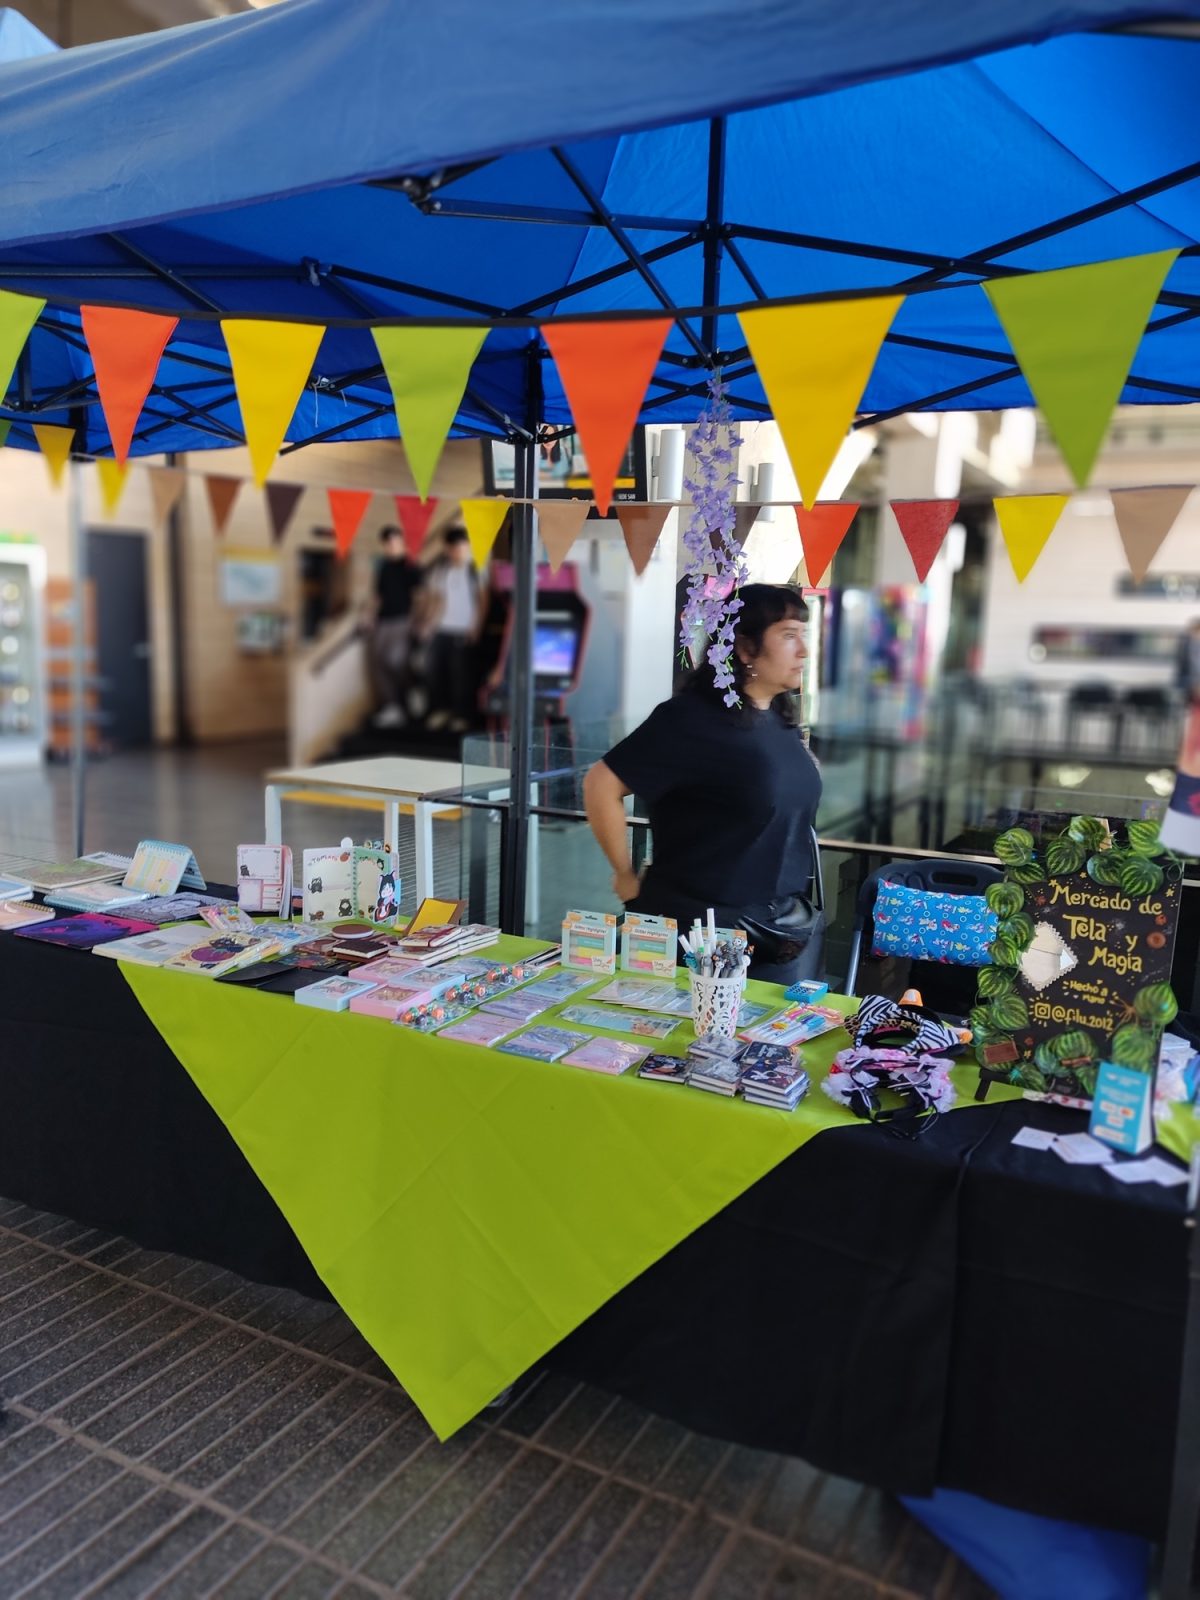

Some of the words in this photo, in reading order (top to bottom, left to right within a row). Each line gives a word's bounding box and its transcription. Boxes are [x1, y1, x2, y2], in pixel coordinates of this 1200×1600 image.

[1050, 884, 1131, 911] Mercado
[1139, 895, 1162, 915] de
[1062, 914, 1106, 942] Tela
[1125, 935, 1138, 952] y
[1088, 946, 1142, 975] Magia
